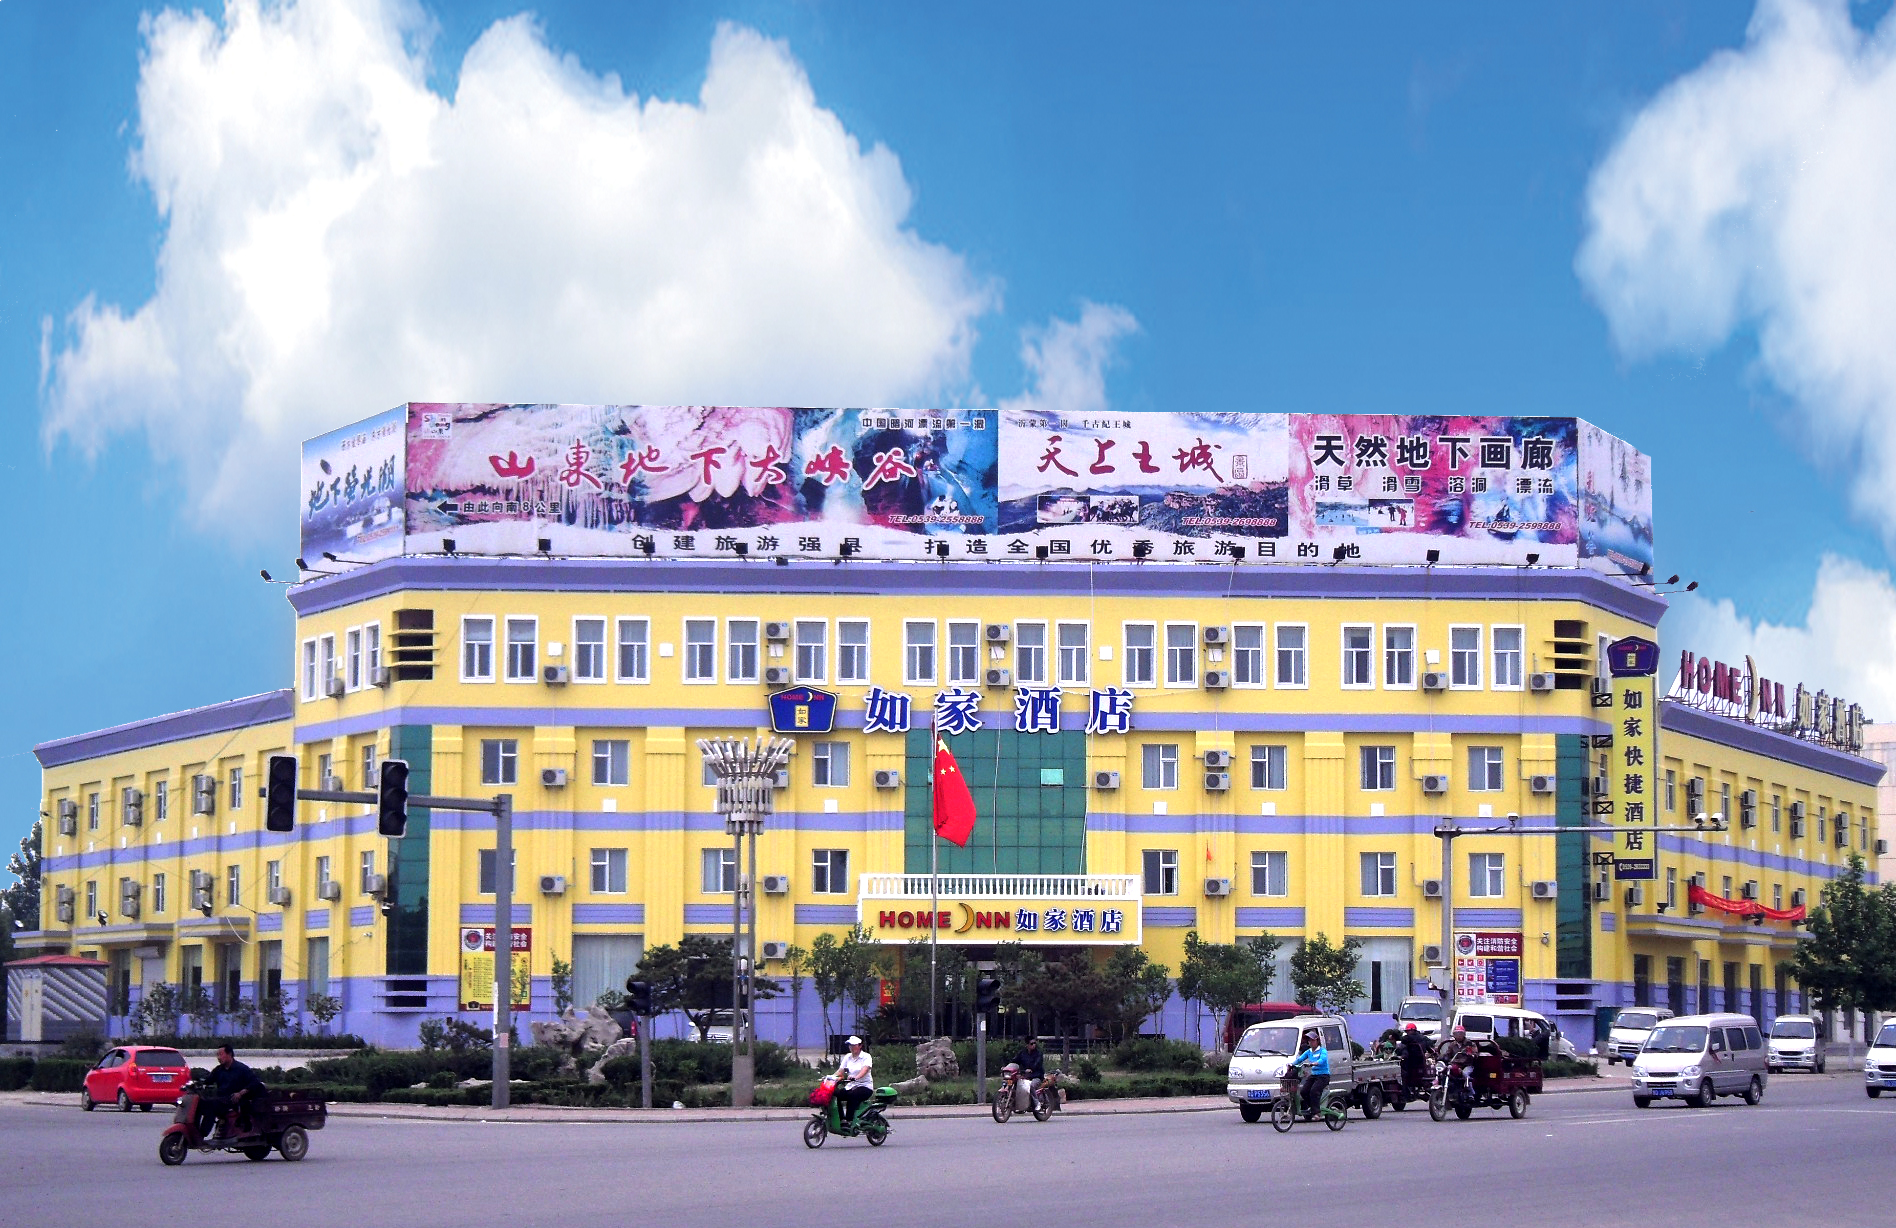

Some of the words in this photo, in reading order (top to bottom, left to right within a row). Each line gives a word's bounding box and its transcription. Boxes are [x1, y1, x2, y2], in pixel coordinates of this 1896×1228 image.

[1037, 435, 1225, 483] 天上王城
[1313, 434, 1556, 470] 天然地下画廊
[1314, 475, 1353, 491] 滑草
[1382, 475, 1422, 492] 滑雪
[1449, 476, 1487, 494] 溶洞
[1516, 477, 1554, 494] 漂流
[462, 501, 562, 515] 由此向南8公里
[1680, 650, 1742, 705] HOME
[863, 685, 1135, 735] 如家酒店
[1622, 688, 1645, 852] 如家快捷酒店
[879, 910, 952, 929] HOME
[1015, 908, 1124, 933] 如家酒店
